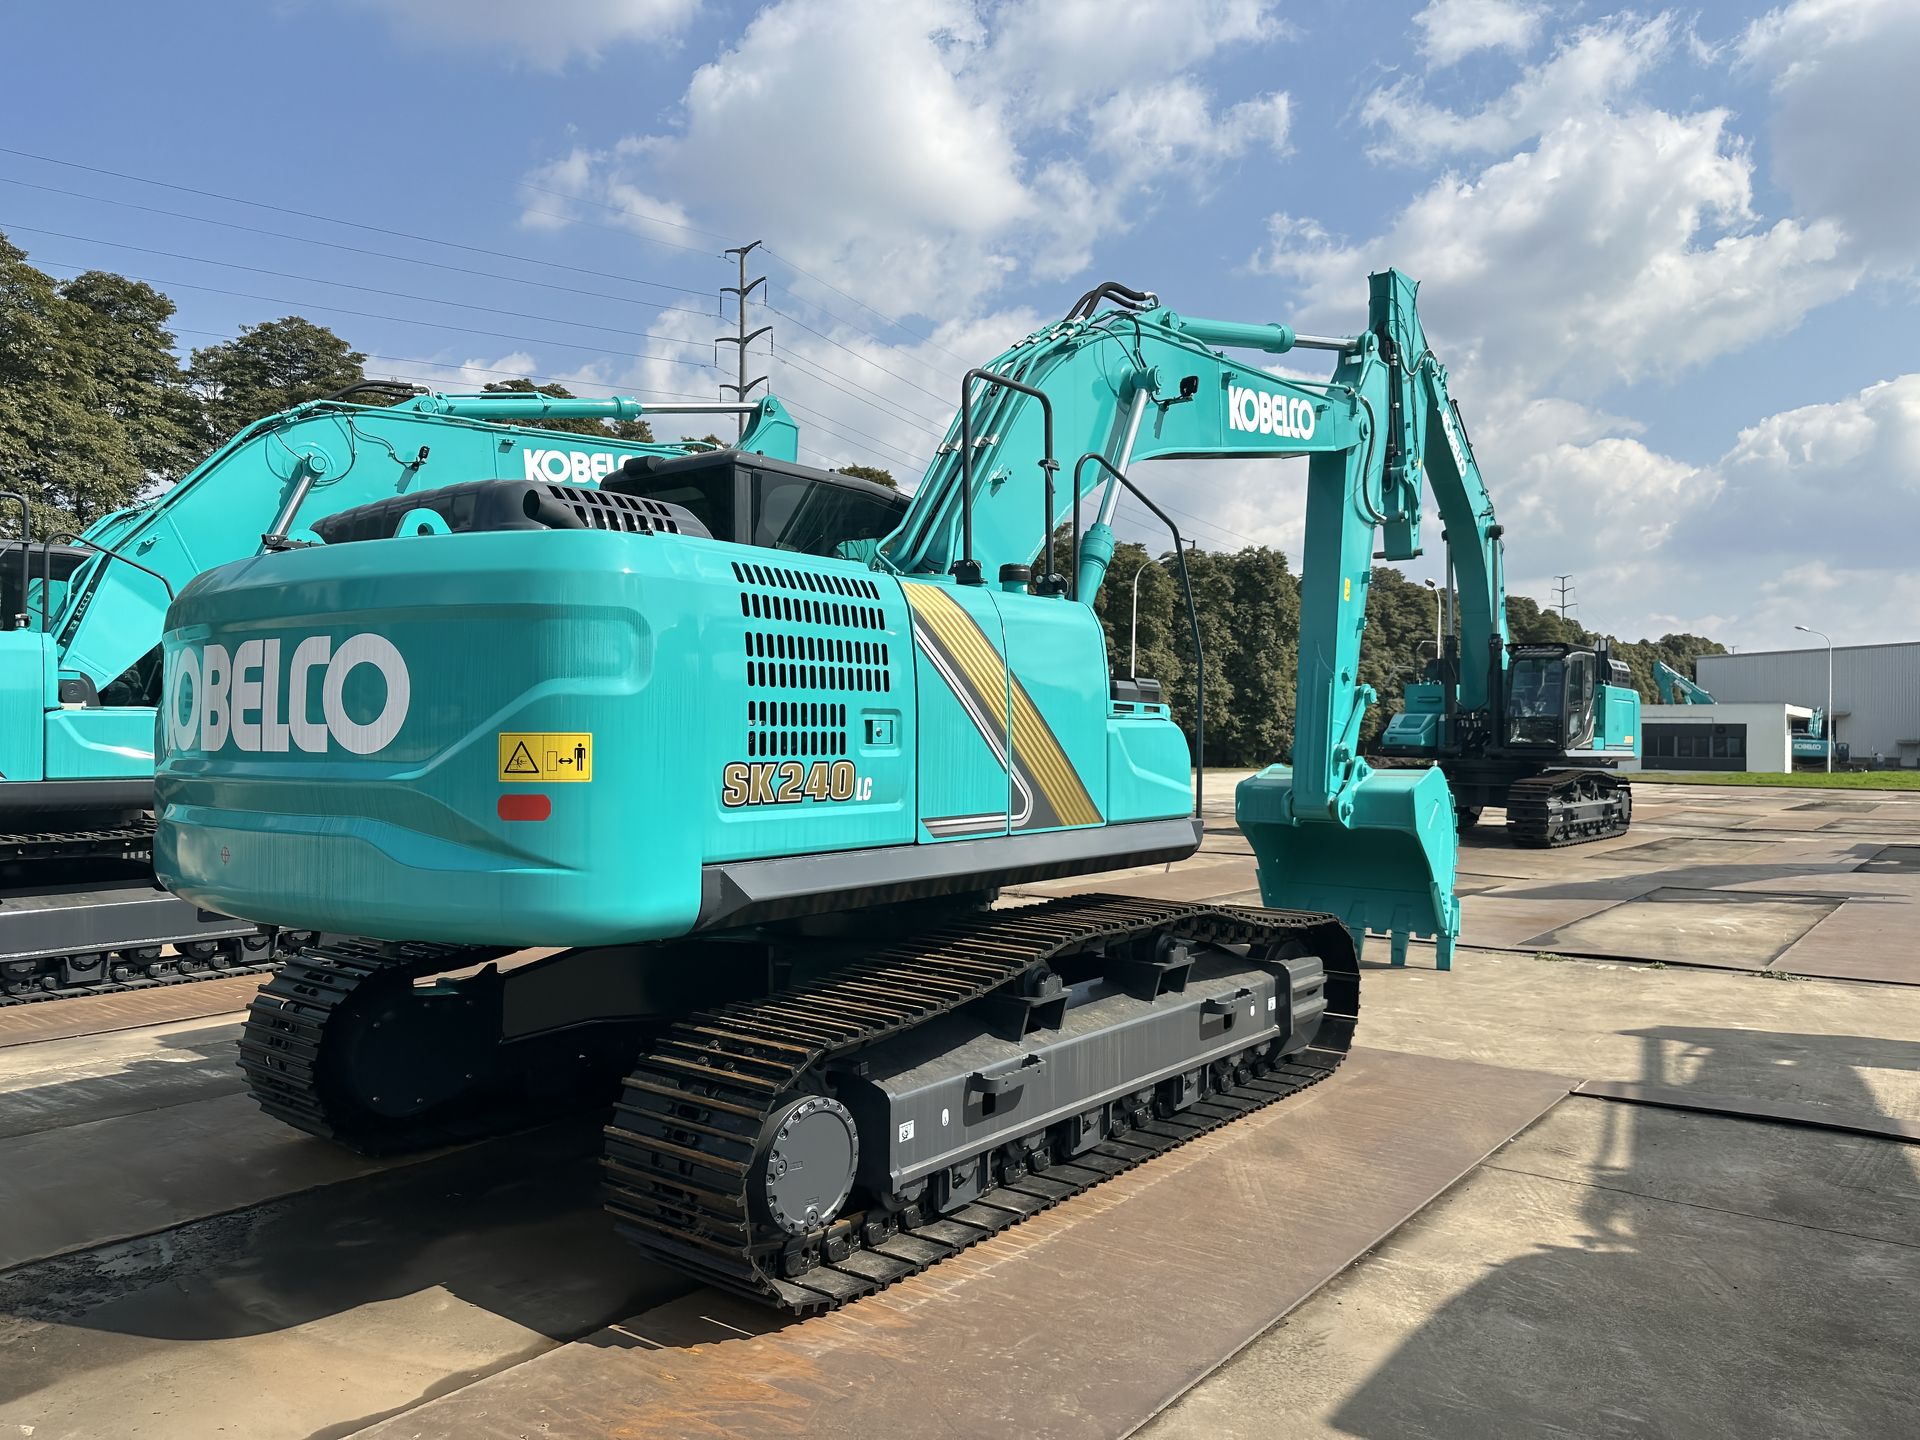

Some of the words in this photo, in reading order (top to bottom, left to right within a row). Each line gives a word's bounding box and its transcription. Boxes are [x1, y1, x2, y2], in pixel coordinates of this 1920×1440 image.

[1228, 385, 1315, 440] KOBELCO
[722, 759, 856, 808] SK240
[855, 777, 873, 801] LC
